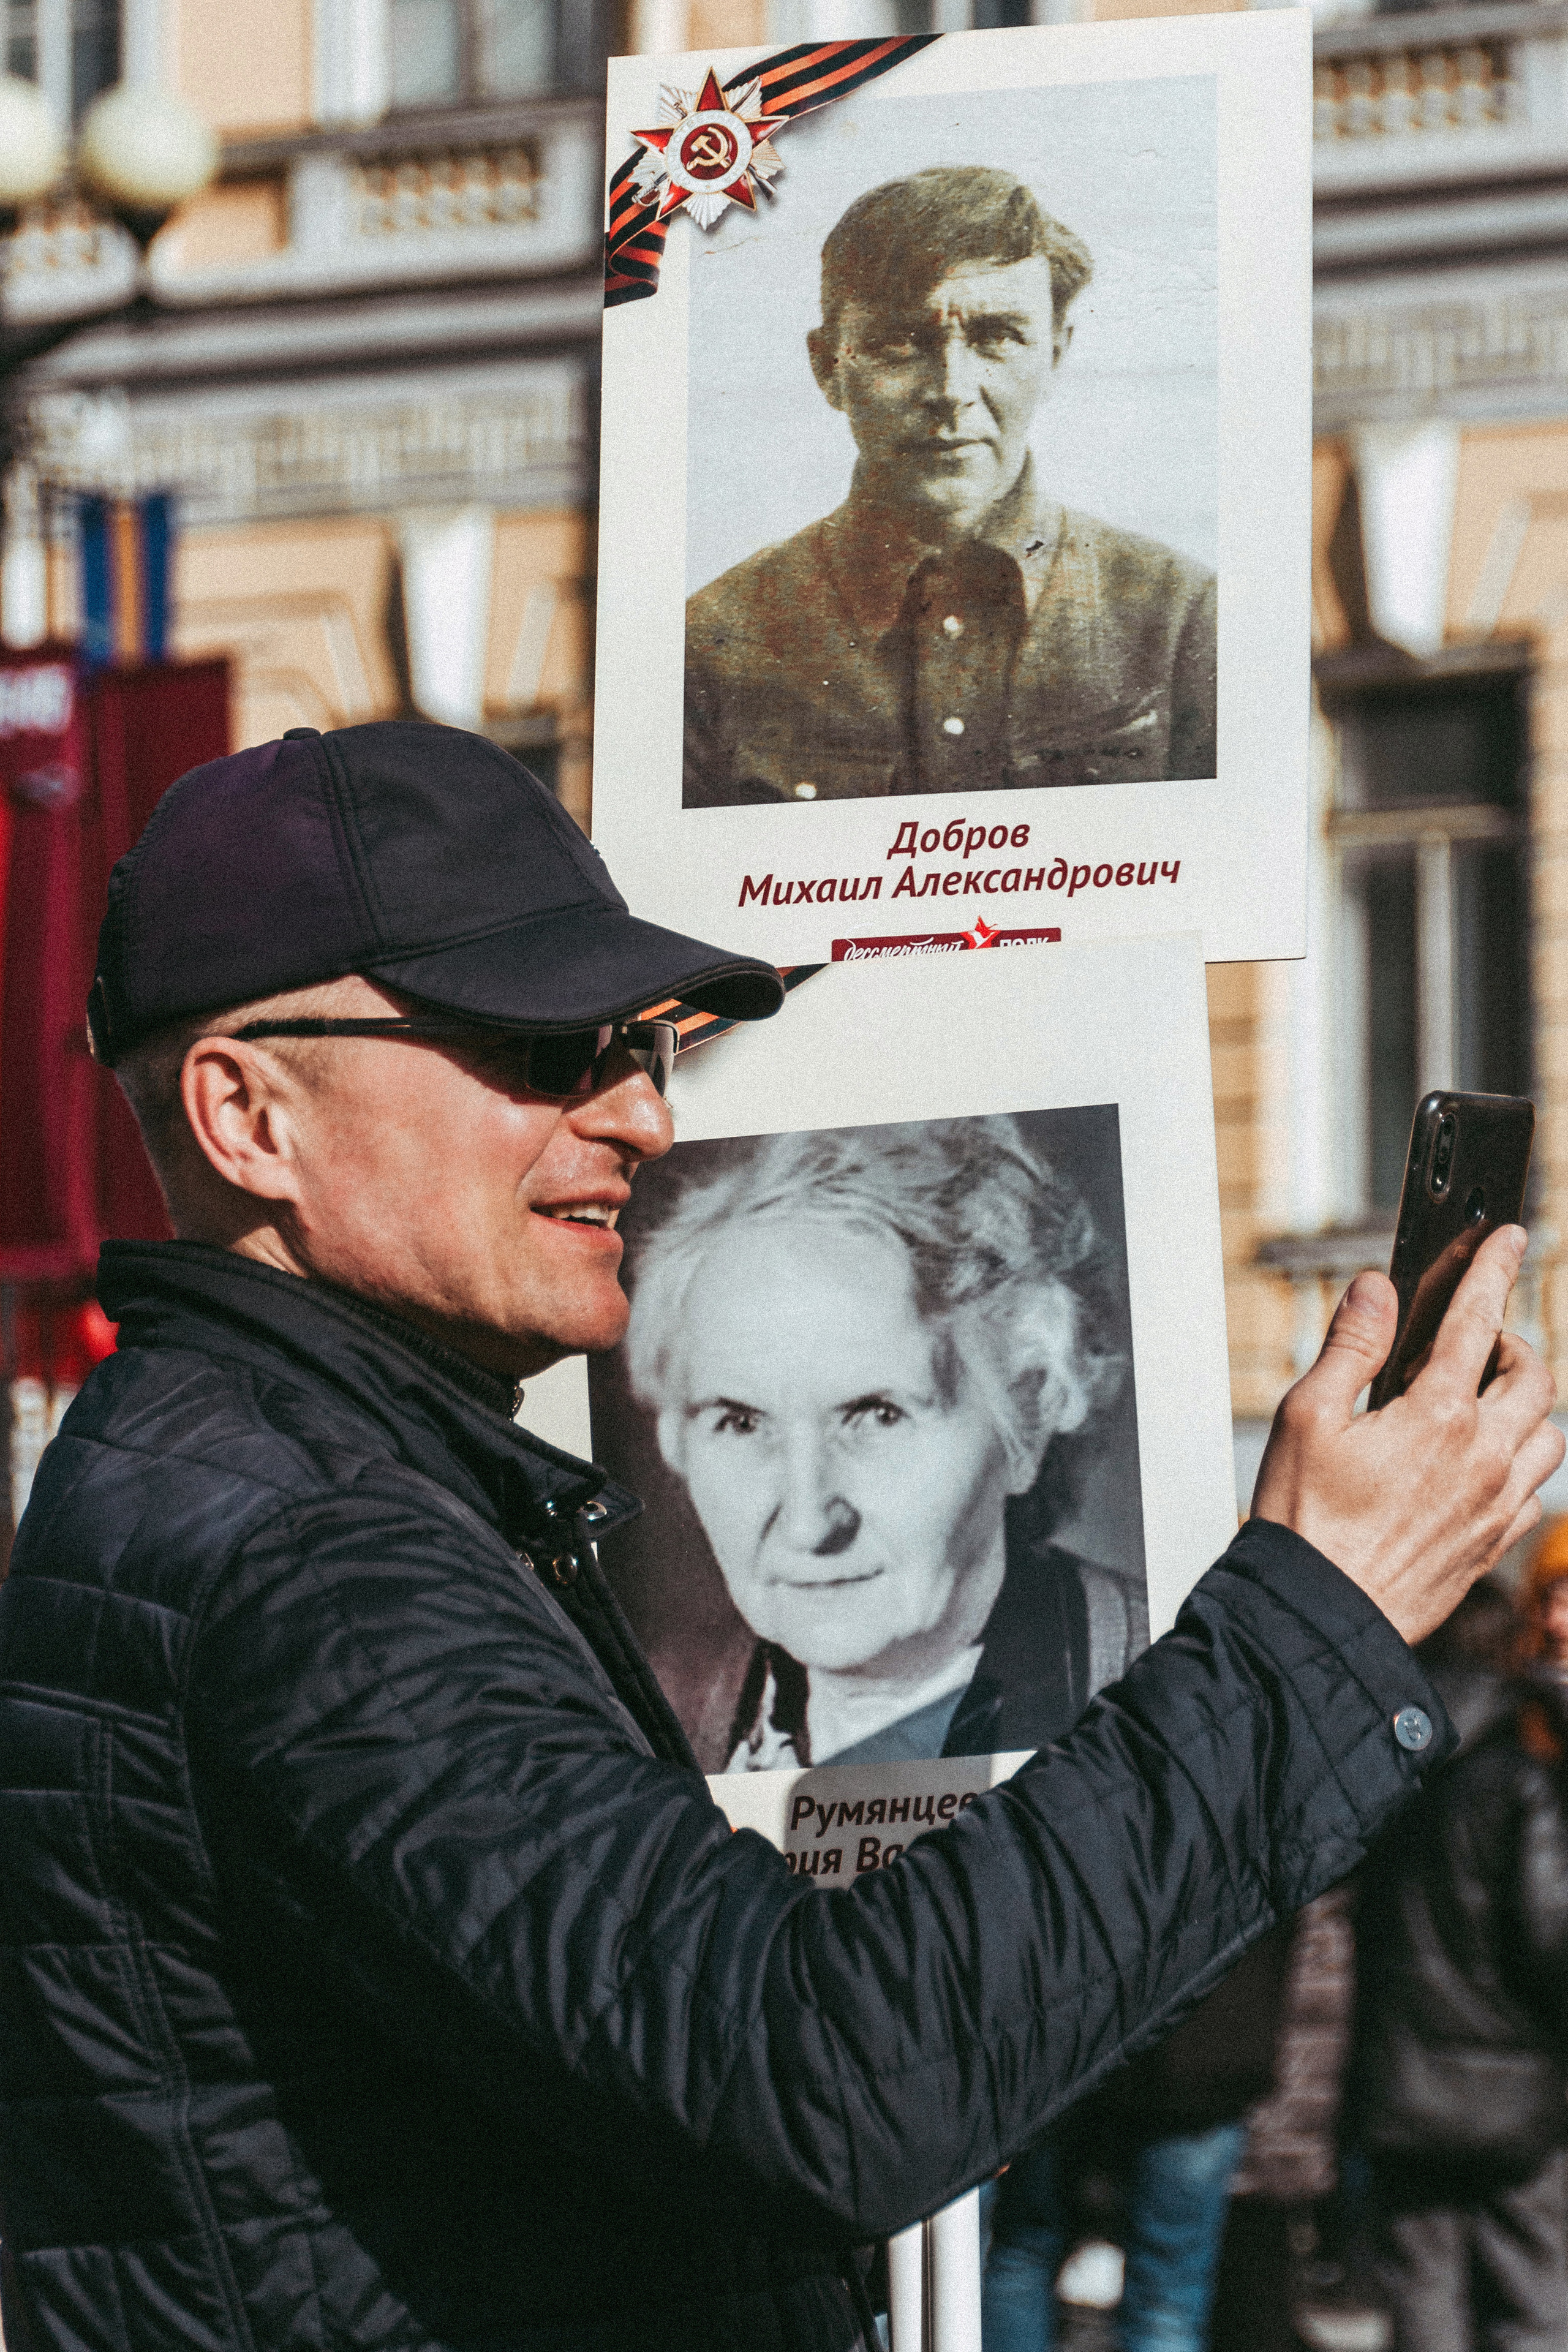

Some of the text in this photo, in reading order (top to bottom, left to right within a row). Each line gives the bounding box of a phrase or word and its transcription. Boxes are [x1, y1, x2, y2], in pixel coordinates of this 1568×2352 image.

[887, 818, 1030, 859] Добров
[738, 858, 1181, 907] Михаил Александрович
